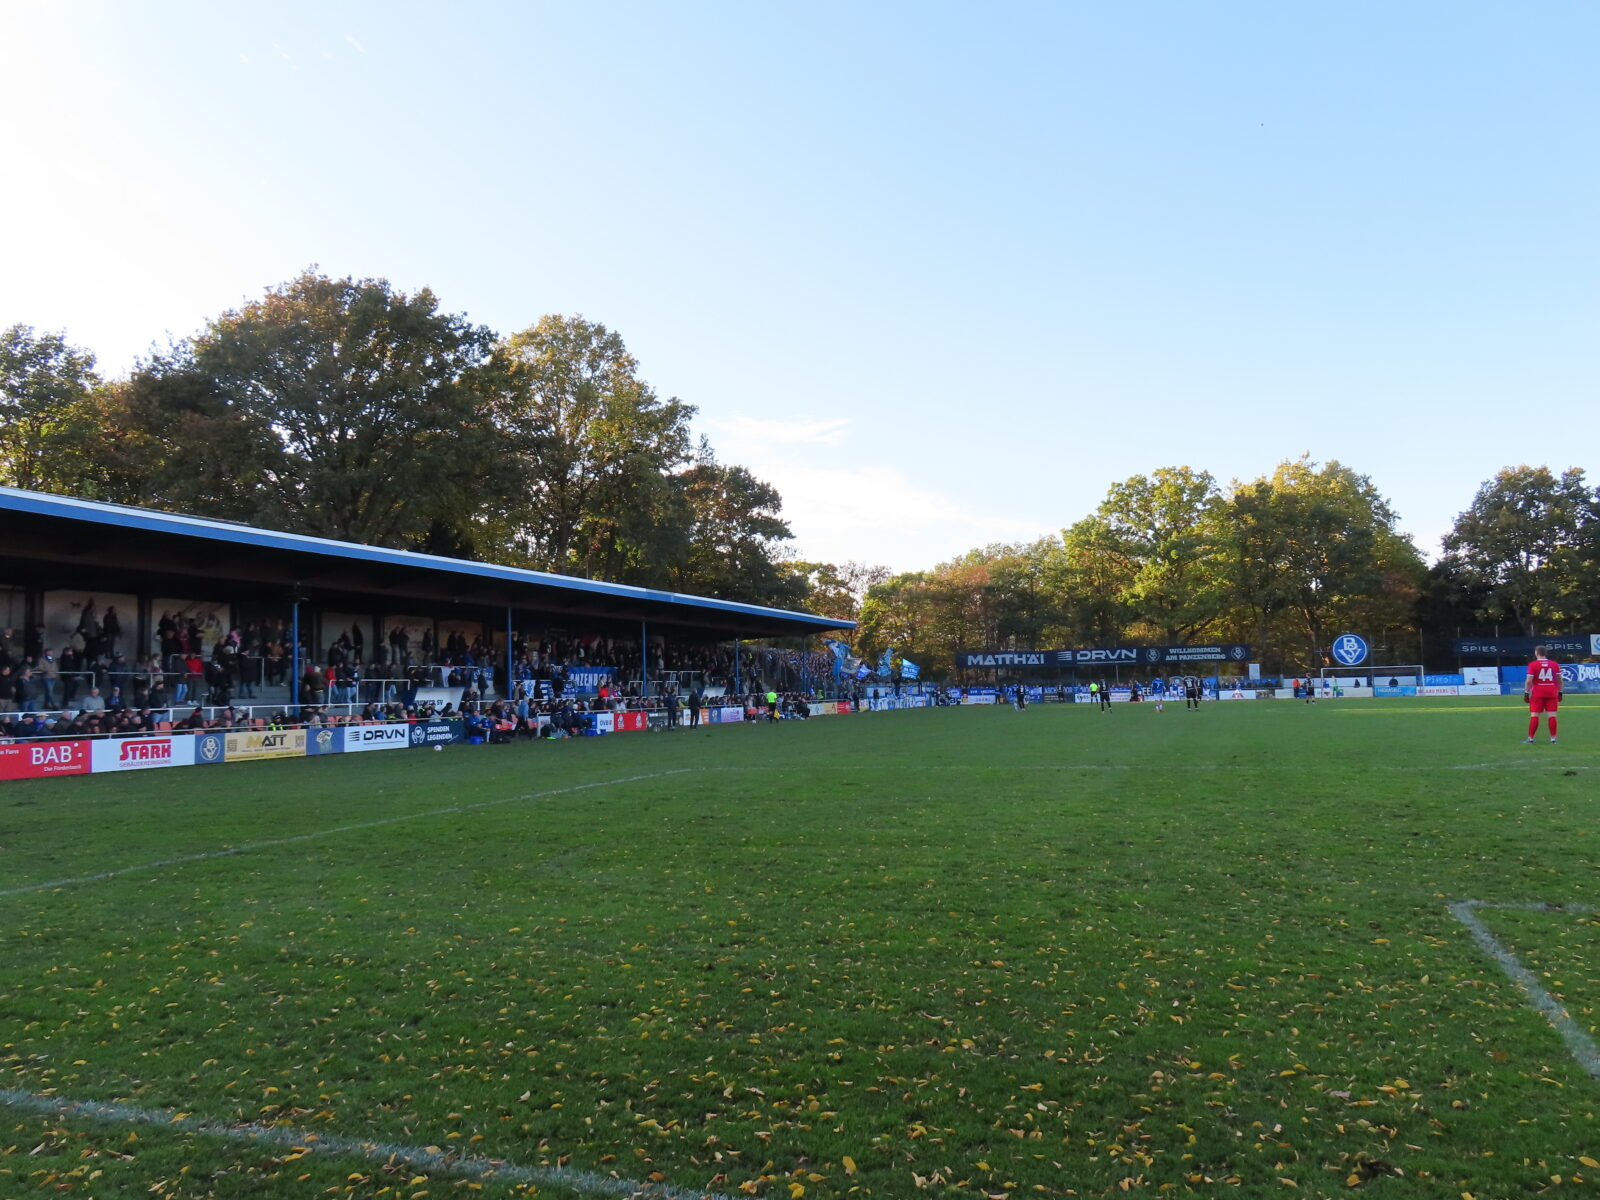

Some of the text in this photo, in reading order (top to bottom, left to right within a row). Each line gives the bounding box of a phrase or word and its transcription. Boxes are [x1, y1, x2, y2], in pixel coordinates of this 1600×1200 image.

[1076, 649, 1137, 660] DRVN
[1538, 667, 1553, 682] 44
[363, 729, 405, 741] DRVN
[31, 745, 72, 765] BAB
[119, 739, 171, 761] STARK
